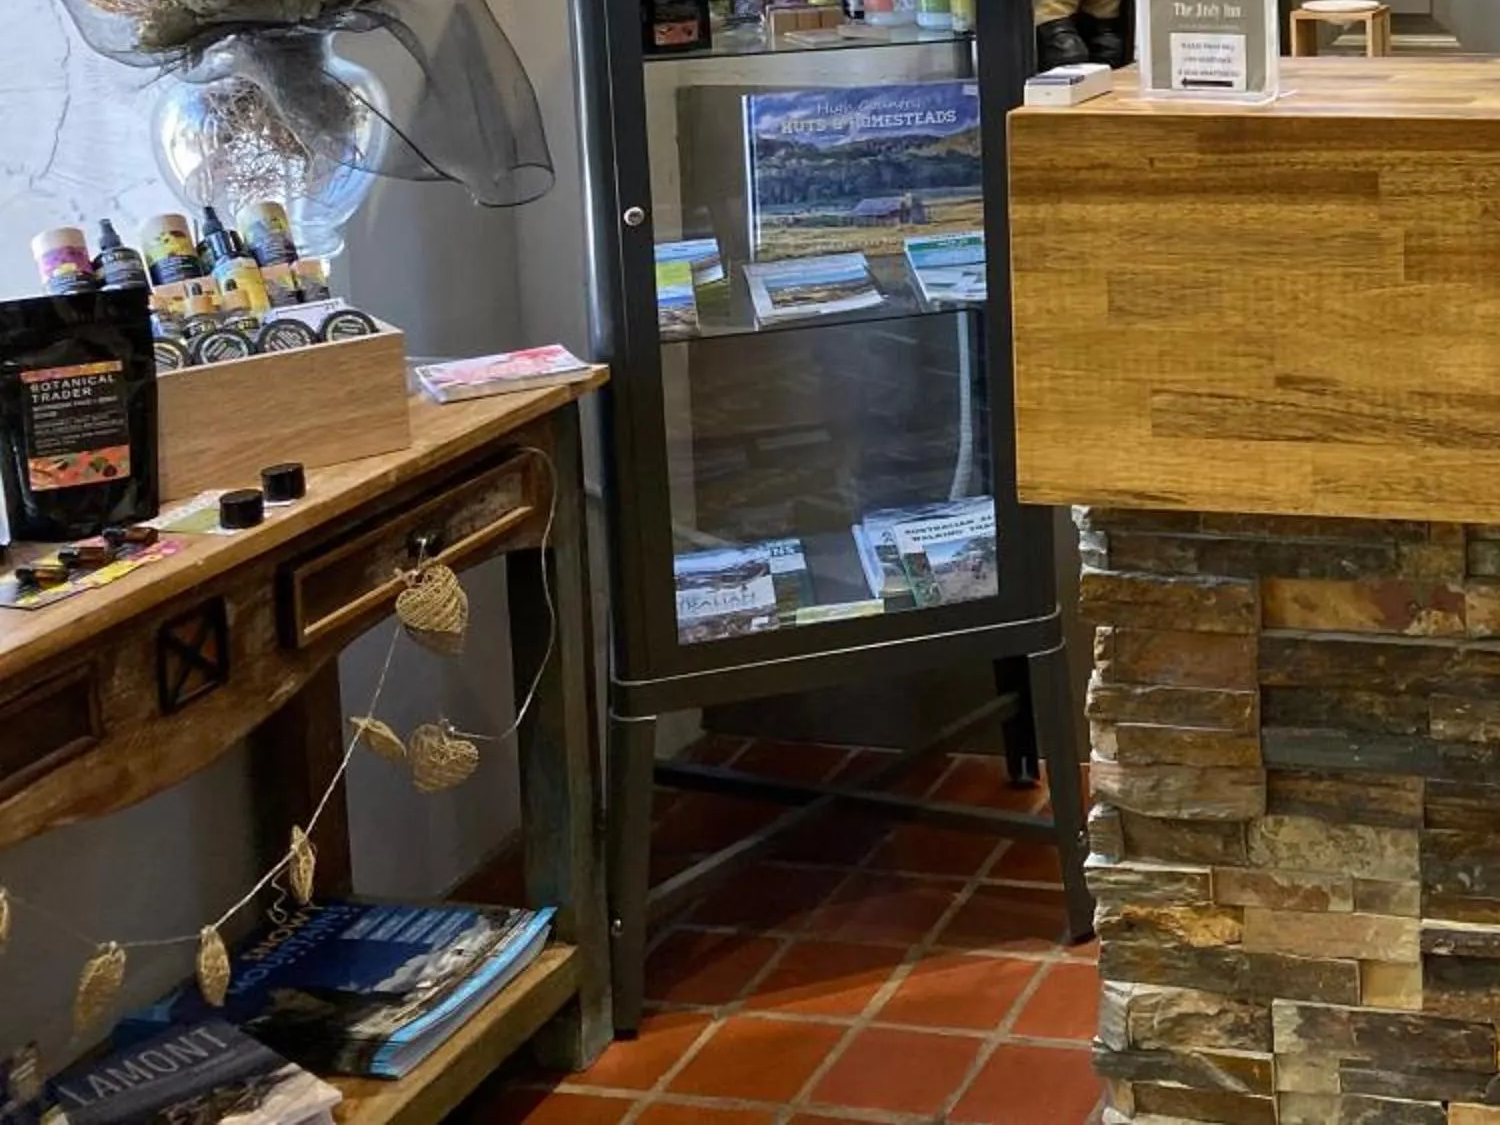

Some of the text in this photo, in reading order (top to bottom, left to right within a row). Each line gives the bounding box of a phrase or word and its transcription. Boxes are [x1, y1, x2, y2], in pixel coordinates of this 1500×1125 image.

[780, 117, 828, 134] HUTS
[849, 109, 957, 128] HOMESTEADS
[30, 374, 115, 393] BOTANICAL
[31, 387, 93, 404] TRADER
[56, 1023, 230, 1108] LAMONT
